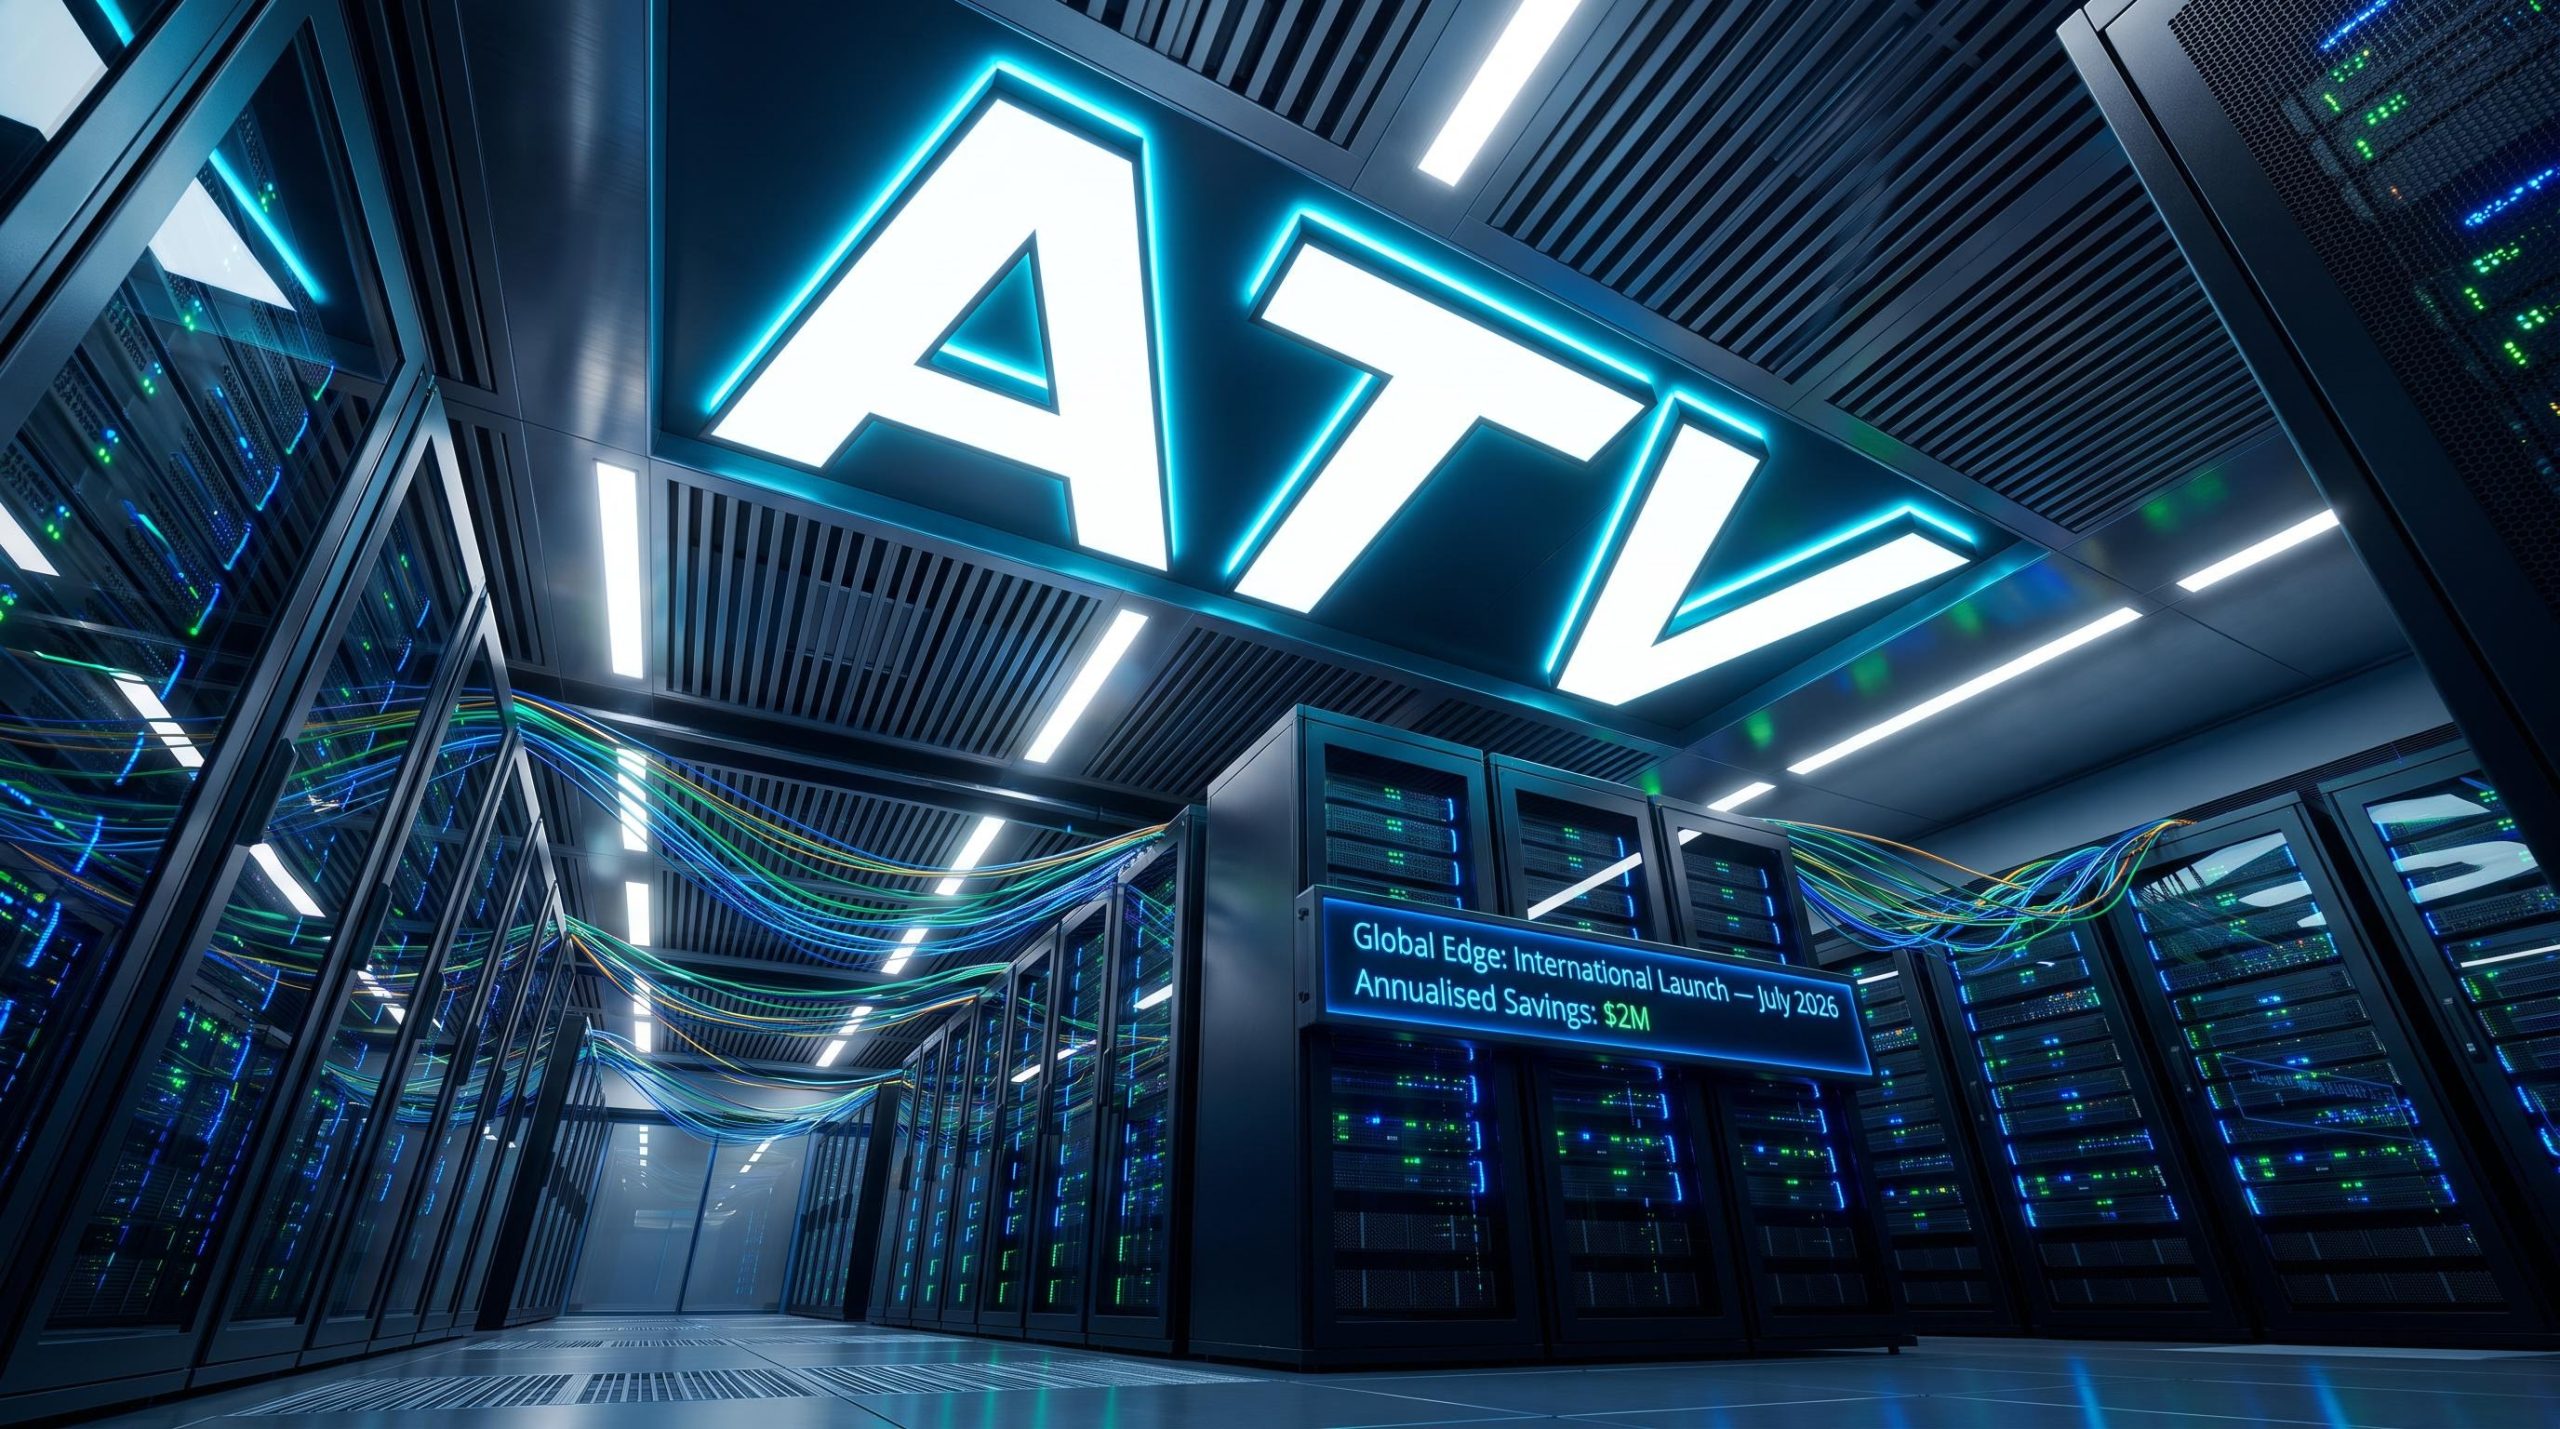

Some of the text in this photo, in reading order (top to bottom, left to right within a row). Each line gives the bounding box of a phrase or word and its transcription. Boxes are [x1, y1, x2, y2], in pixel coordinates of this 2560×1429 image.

[709, 98, 1976, 708] ATV
[1353, 922, 1435, 960] Global
[1443, 935, 1508, 975] Edge:
[1514, 945, 1653, 992] International
[1657, 968, 1730, 1003] Launch
[1757, 984, 1791, 1018] July
[1793, 990, 1840, 1019] 2026
[1354, 968, 1651, 1031] Annualised Savings: $2M
